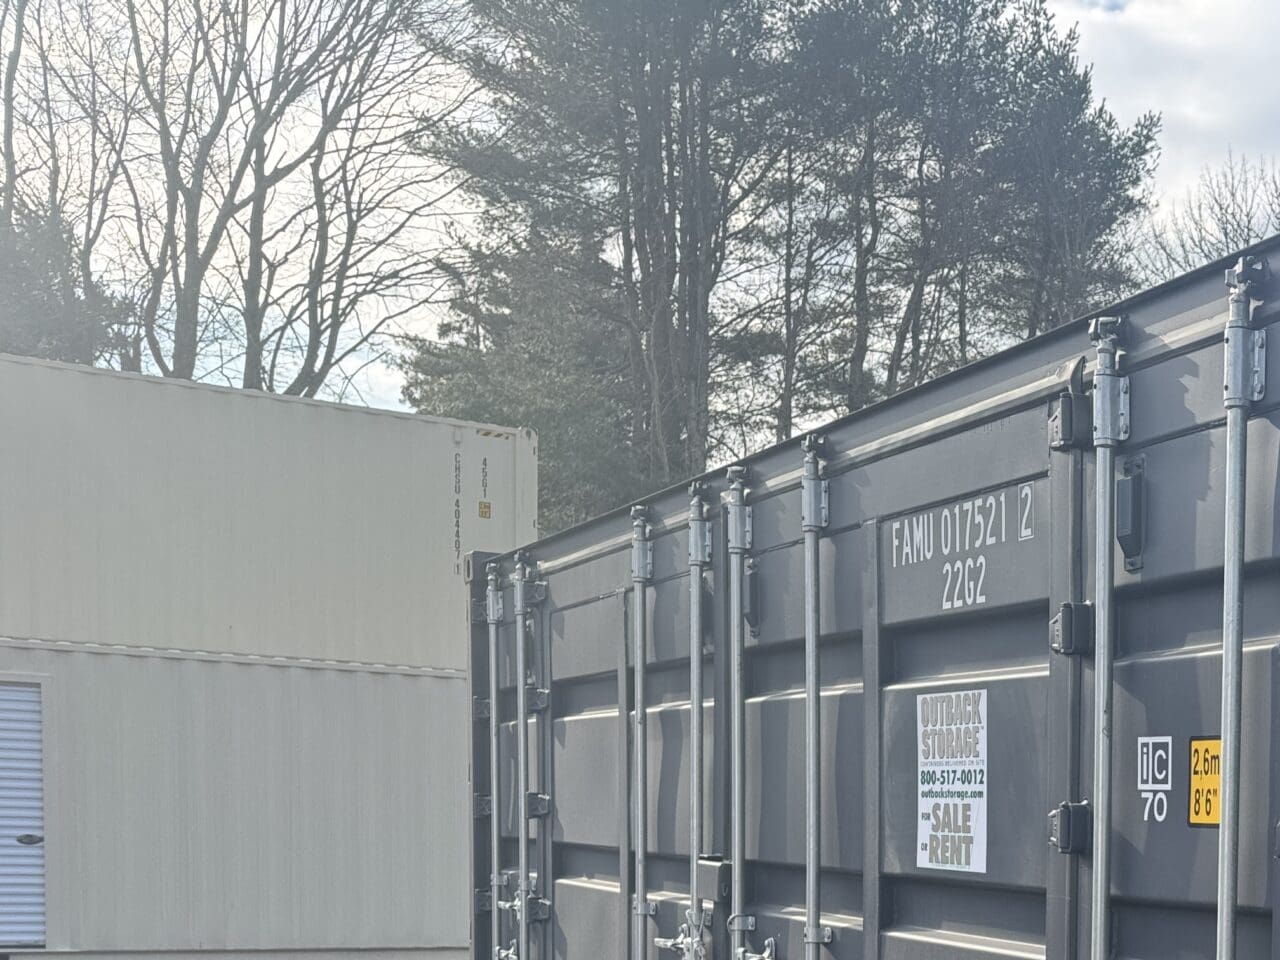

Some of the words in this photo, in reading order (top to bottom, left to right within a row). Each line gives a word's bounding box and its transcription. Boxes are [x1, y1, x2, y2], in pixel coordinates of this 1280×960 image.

[892, 512, 934, 568] FAMU
[941, 492, 1006, 556] 017521
[1020, 486, 1032, 538] 2
[942, 555, 986, 610] 22G2
[920, 691, 982, 728] OUTBACK
[921, 725, 980, 760] STORAGE
[920, 769, 985, 786] 800-517-0012
[1193, 748, 1220, 780] 2,6m
[920, 787, 984, 801] outbackstorage.com
[1141, 792, 1167, 822] 70
[1194, 788, 1218, 816] 8'6"
[921, 812, 931, 821] FOR
[931, 802, 971, 834] SALE
[920, 842, 928, 851] OR
[928, 833, 974, 866] RENT
